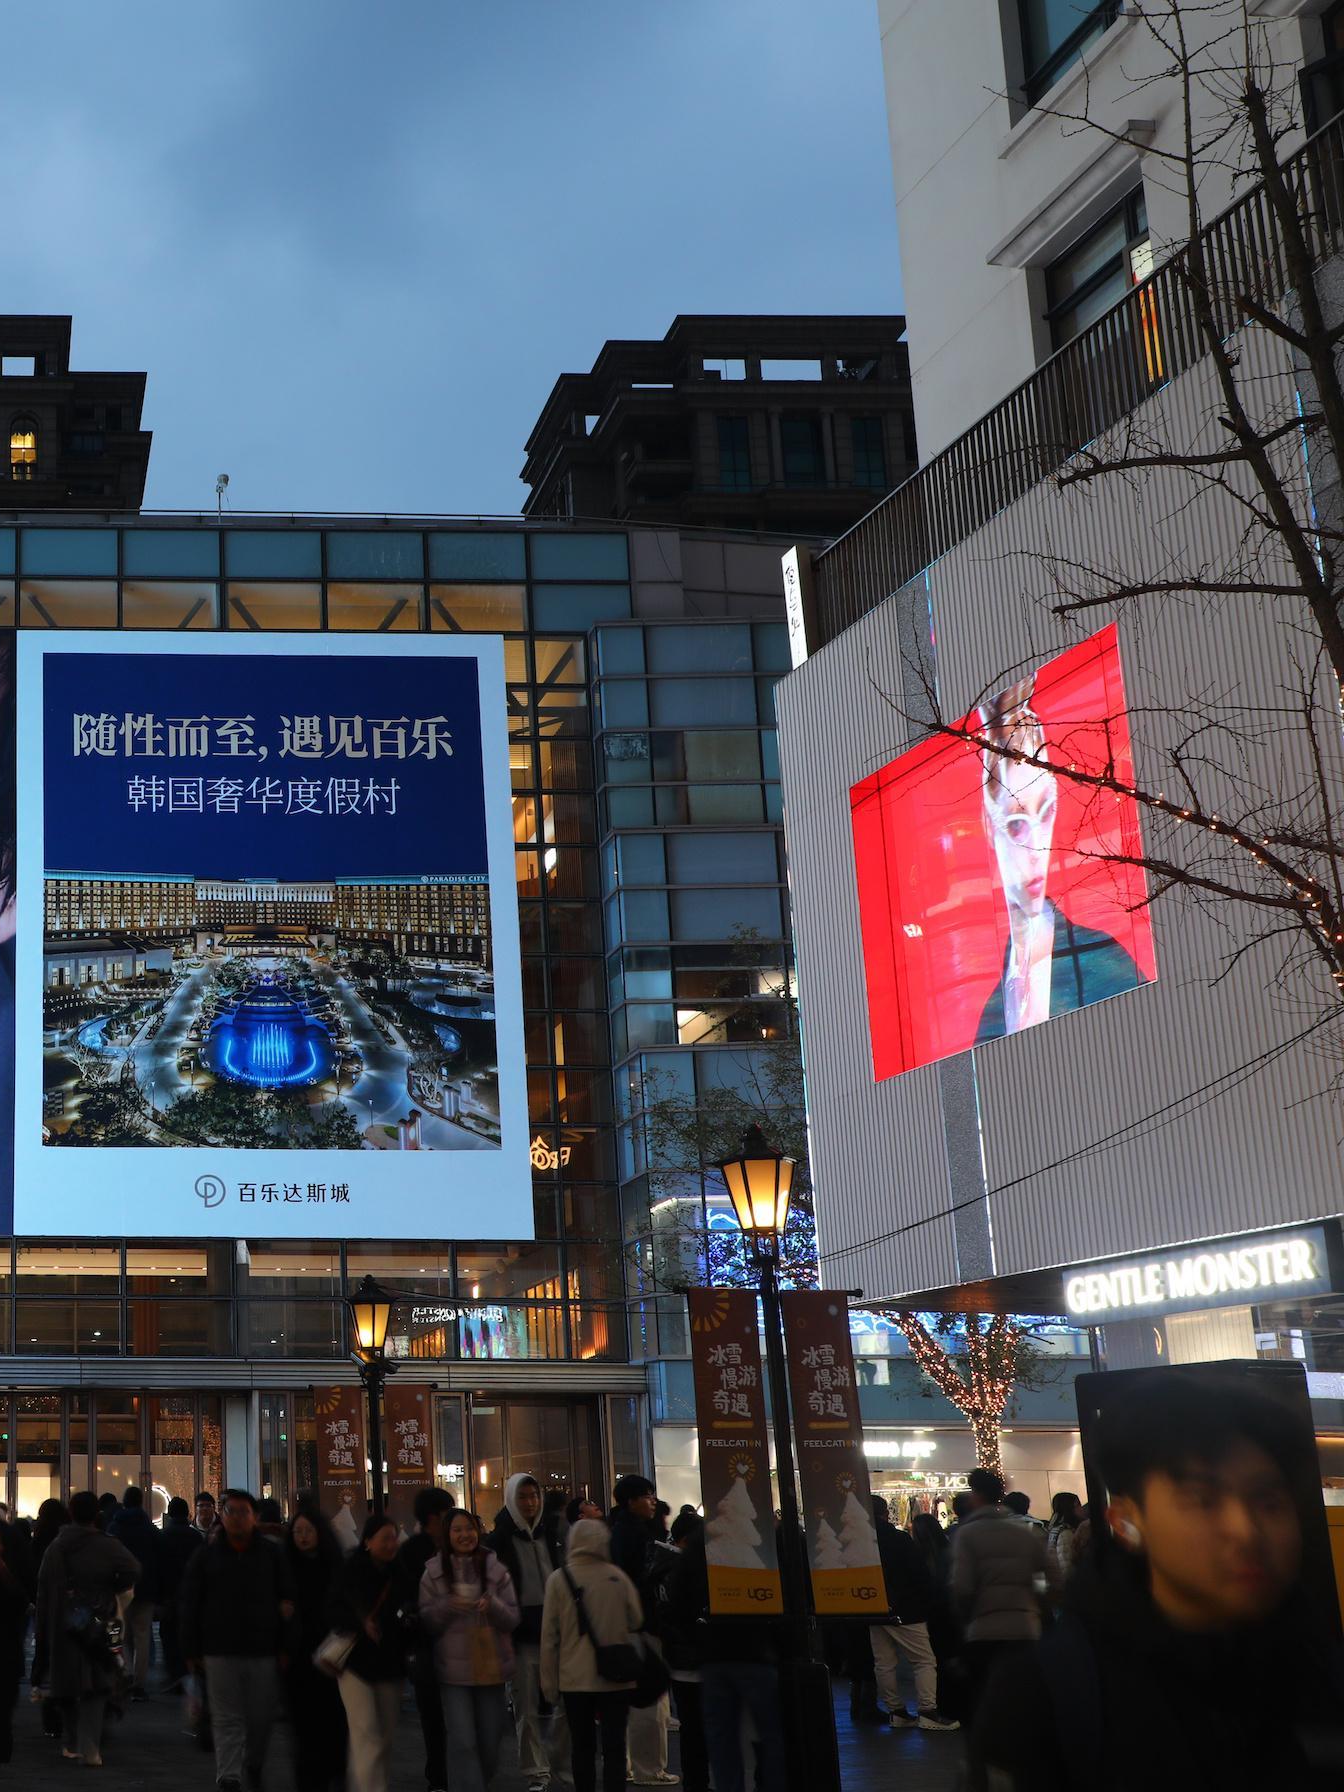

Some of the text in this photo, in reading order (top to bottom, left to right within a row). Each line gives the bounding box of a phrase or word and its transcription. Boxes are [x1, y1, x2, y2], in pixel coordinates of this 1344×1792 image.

[72, 712, 455, 763] 随性而至,遇见百乐
[126, 775, 401, 815] 韩国奢华度假村
[429, 875, 465, 883] PARADISE
[237, 1183, 351, 1203] 百乐达斯城
[1067, 1239, 1317, 1313] GENTLE MONSTER
[708, 1343, 743, 1367] 冰雪
[801, 1344, 836, 1368] 冰雪
[720, 1365, 756, 1390] 慢游
[814, 1366, 850, 1391] 慢游
[712, 1390, 751, 1417] 奇遇
[808, 1390, 847, 1417] 奇遇
[325, 1420, 350, 1436] 冰雪
[394, 1419, 419, 1436] 冰雪
[333, 1433, 359, 1450] 慢游
[402, 1433, 428, 1450] 慢游
[328, 1449, 355, 1466] 奇遇
[397, 1449, 424, 1466] 奇遇
